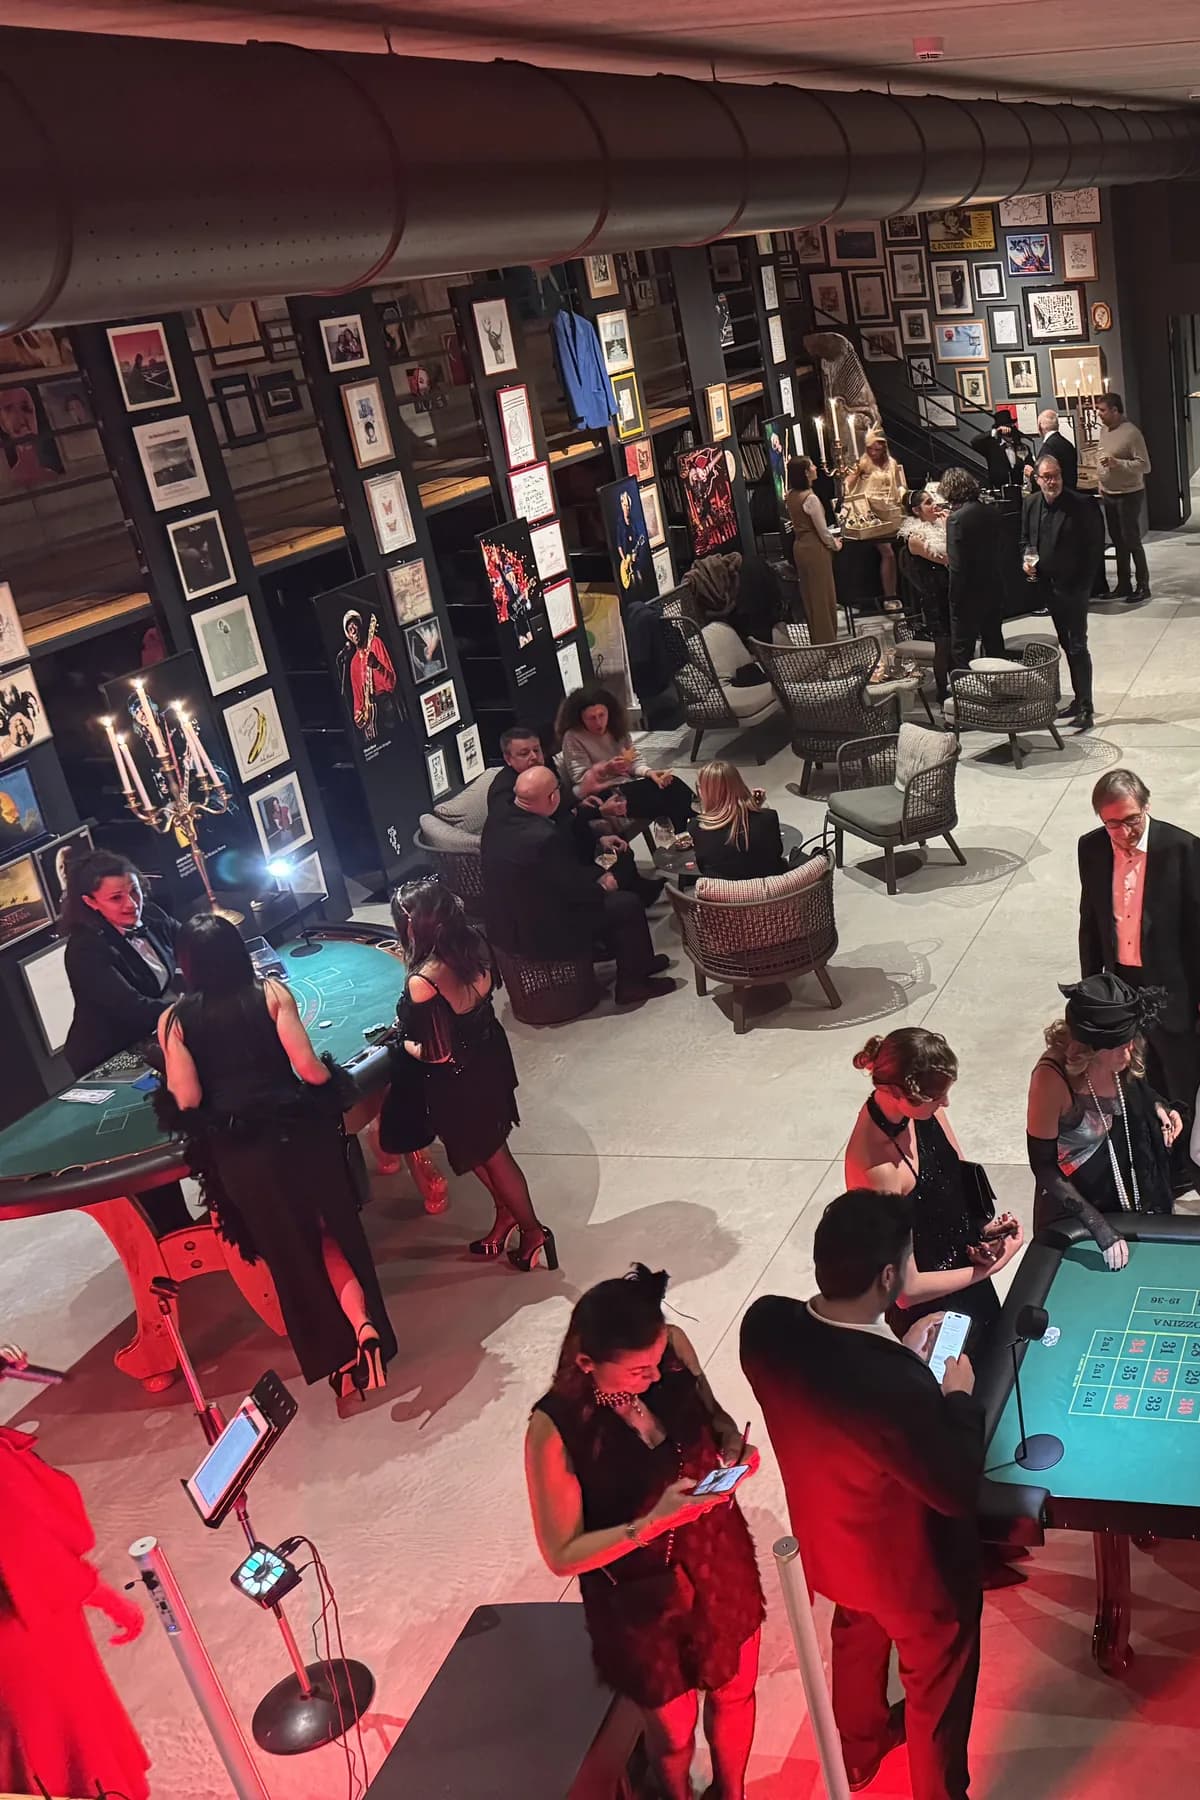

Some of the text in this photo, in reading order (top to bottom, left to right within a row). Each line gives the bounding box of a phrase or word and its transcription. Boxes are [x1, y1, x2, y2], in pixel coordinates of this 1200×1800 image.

[1150, 1296, 1181, 1305] 19-36
[1160, 1341, 1176, 1354] 31
[1121, 1365, 1138, 1381] 35
[1185, 1369, 1200, 1385] 29
[1145, 1395, 1162, 1412] 33
